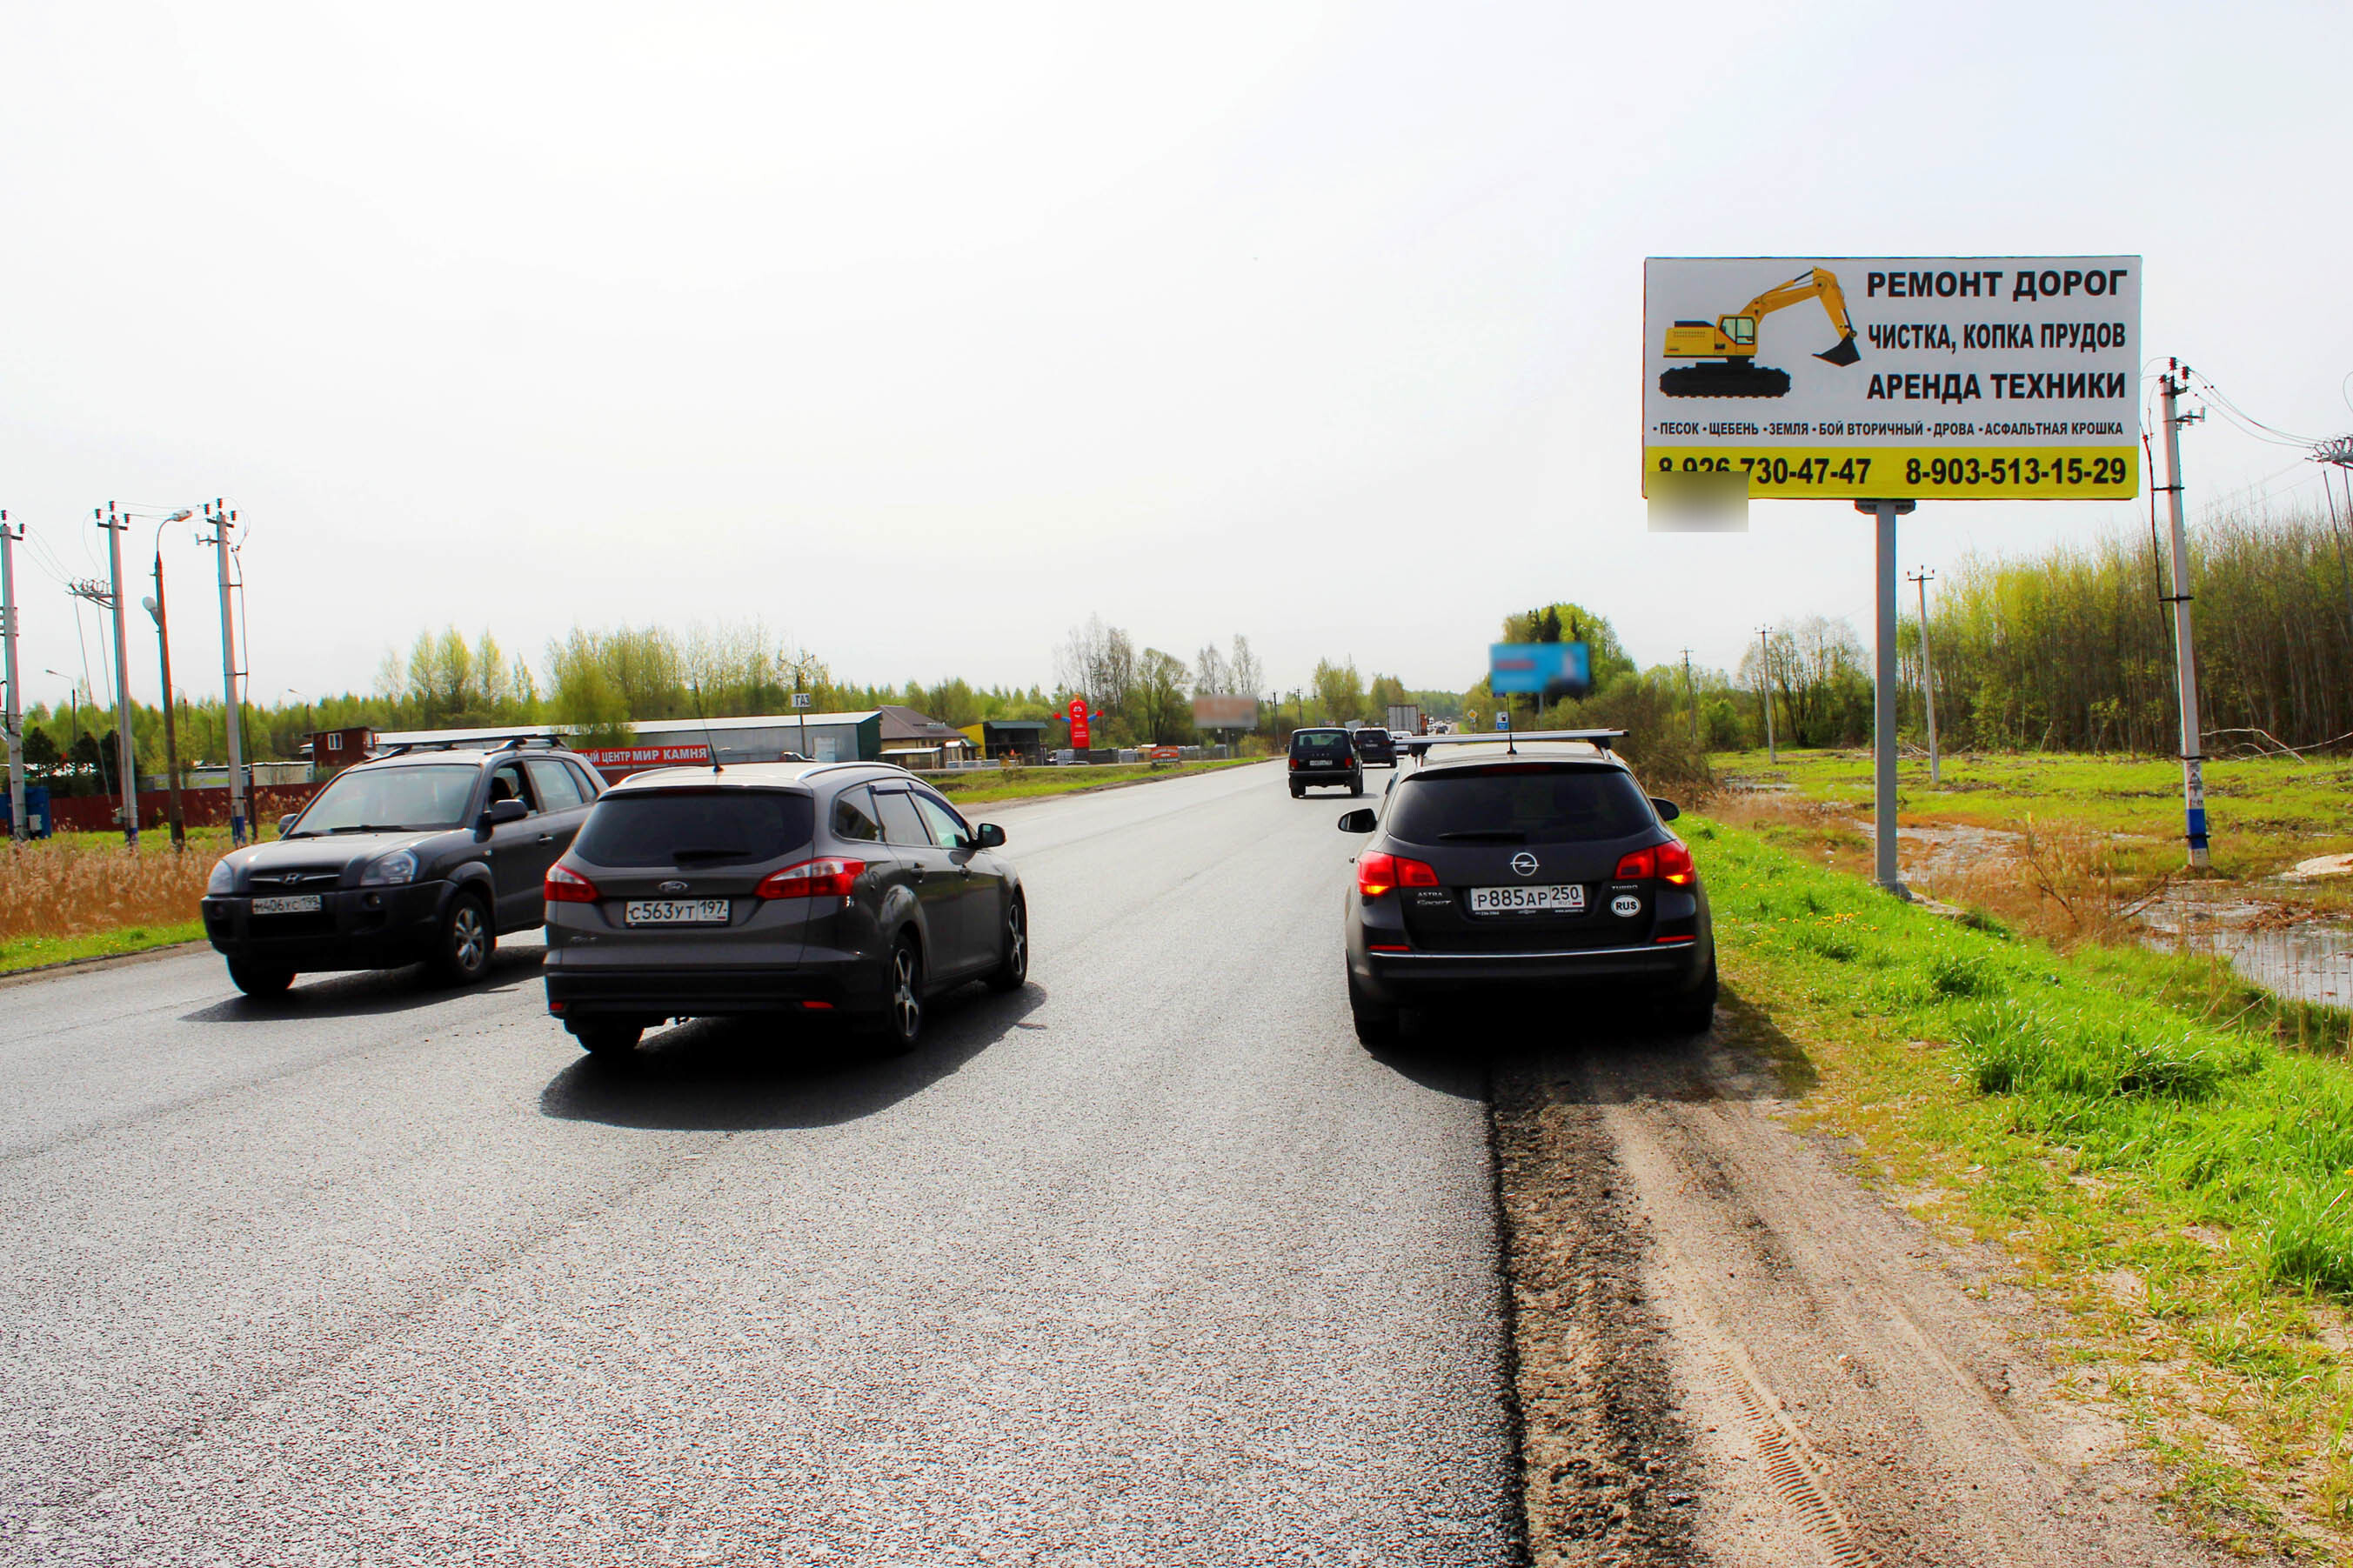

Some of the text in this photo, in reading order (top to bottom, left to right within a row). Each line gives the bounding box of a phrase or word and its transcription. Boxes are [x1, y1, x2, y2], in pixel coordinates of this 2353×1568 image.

[1868, 270, 2128, 303] РЕМОНТ ДОРОГ
[1868, 322, 2126, 355] ЧИСТКА, КОПКА ПРУДОВ
[1867, 372, 2125, 403] АРЕНДА ТЕХНИКИ
[1848, 421, 1923, 435] ВТОРИЧНЫЙ
[2071, 423, 2123, 435] КРОШКА
[1905, 457, 2126, 485] 8-903-513-15-29
[795, 695, 810, 706] ГАЗ
[601, 751, 631, 764] ЦЕНТР
[632, 751, 659, 761] МИР
[663, 747, 707, 760] КАМНЯ
[1552, 887, 1580, 901] 250
[699, 901, 725, 914] 197
[1615, 900, 1637, 911] RUS
